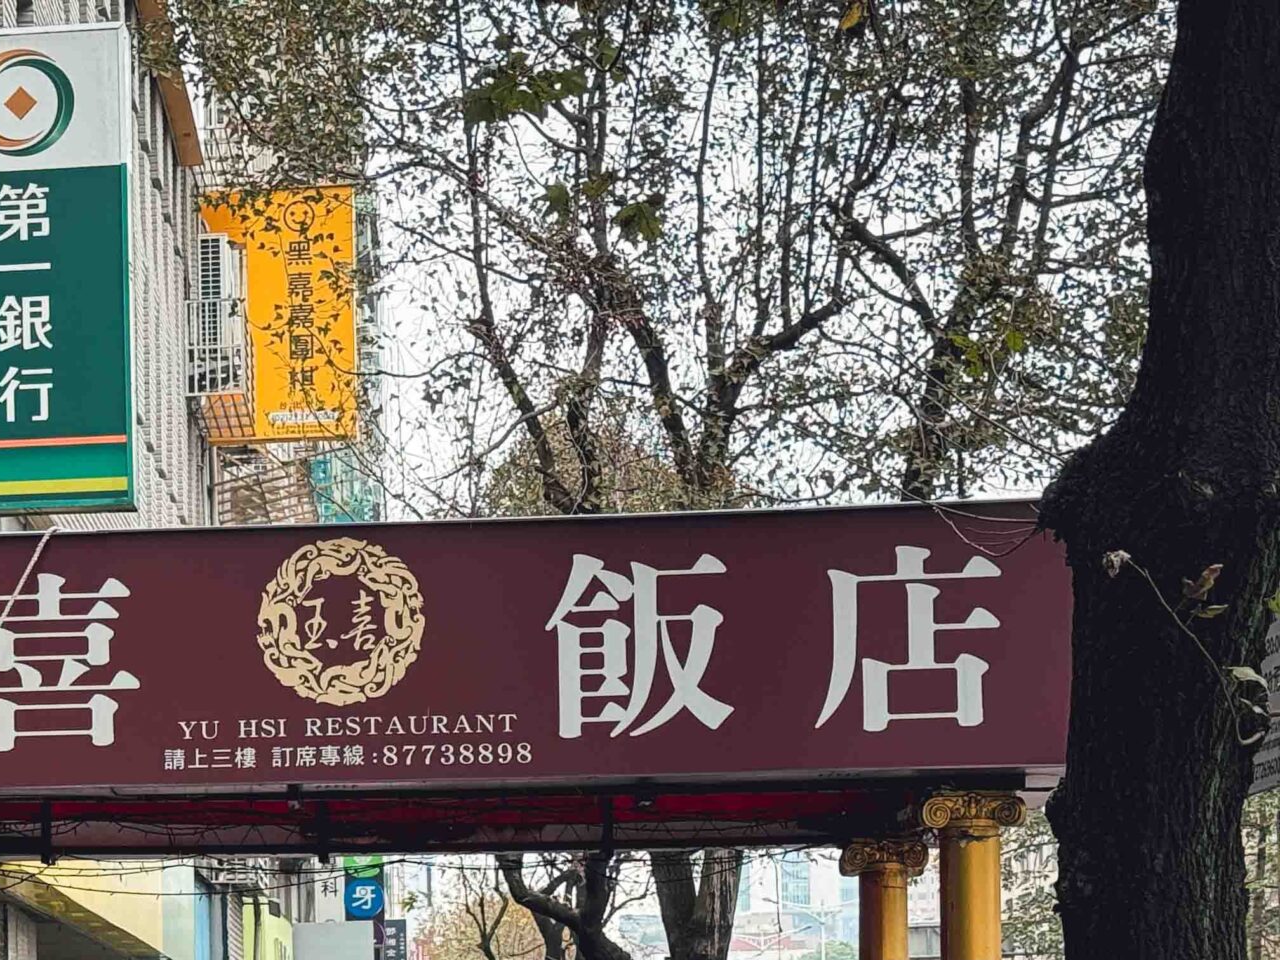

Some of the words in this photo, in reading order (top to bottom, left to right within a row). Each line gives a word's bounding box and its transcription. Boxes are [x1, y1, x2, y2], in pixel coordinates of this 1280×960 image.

[546, 546, 1001, 738] 飯店
[178, 720, 220, 740] YU
[238, 718, 287, 738] HSI
[305, 714, 518, 737] RESTAURANT
[164, 746, 257, 770] 請上三樓
[352, 886, 376, 910] 牙
